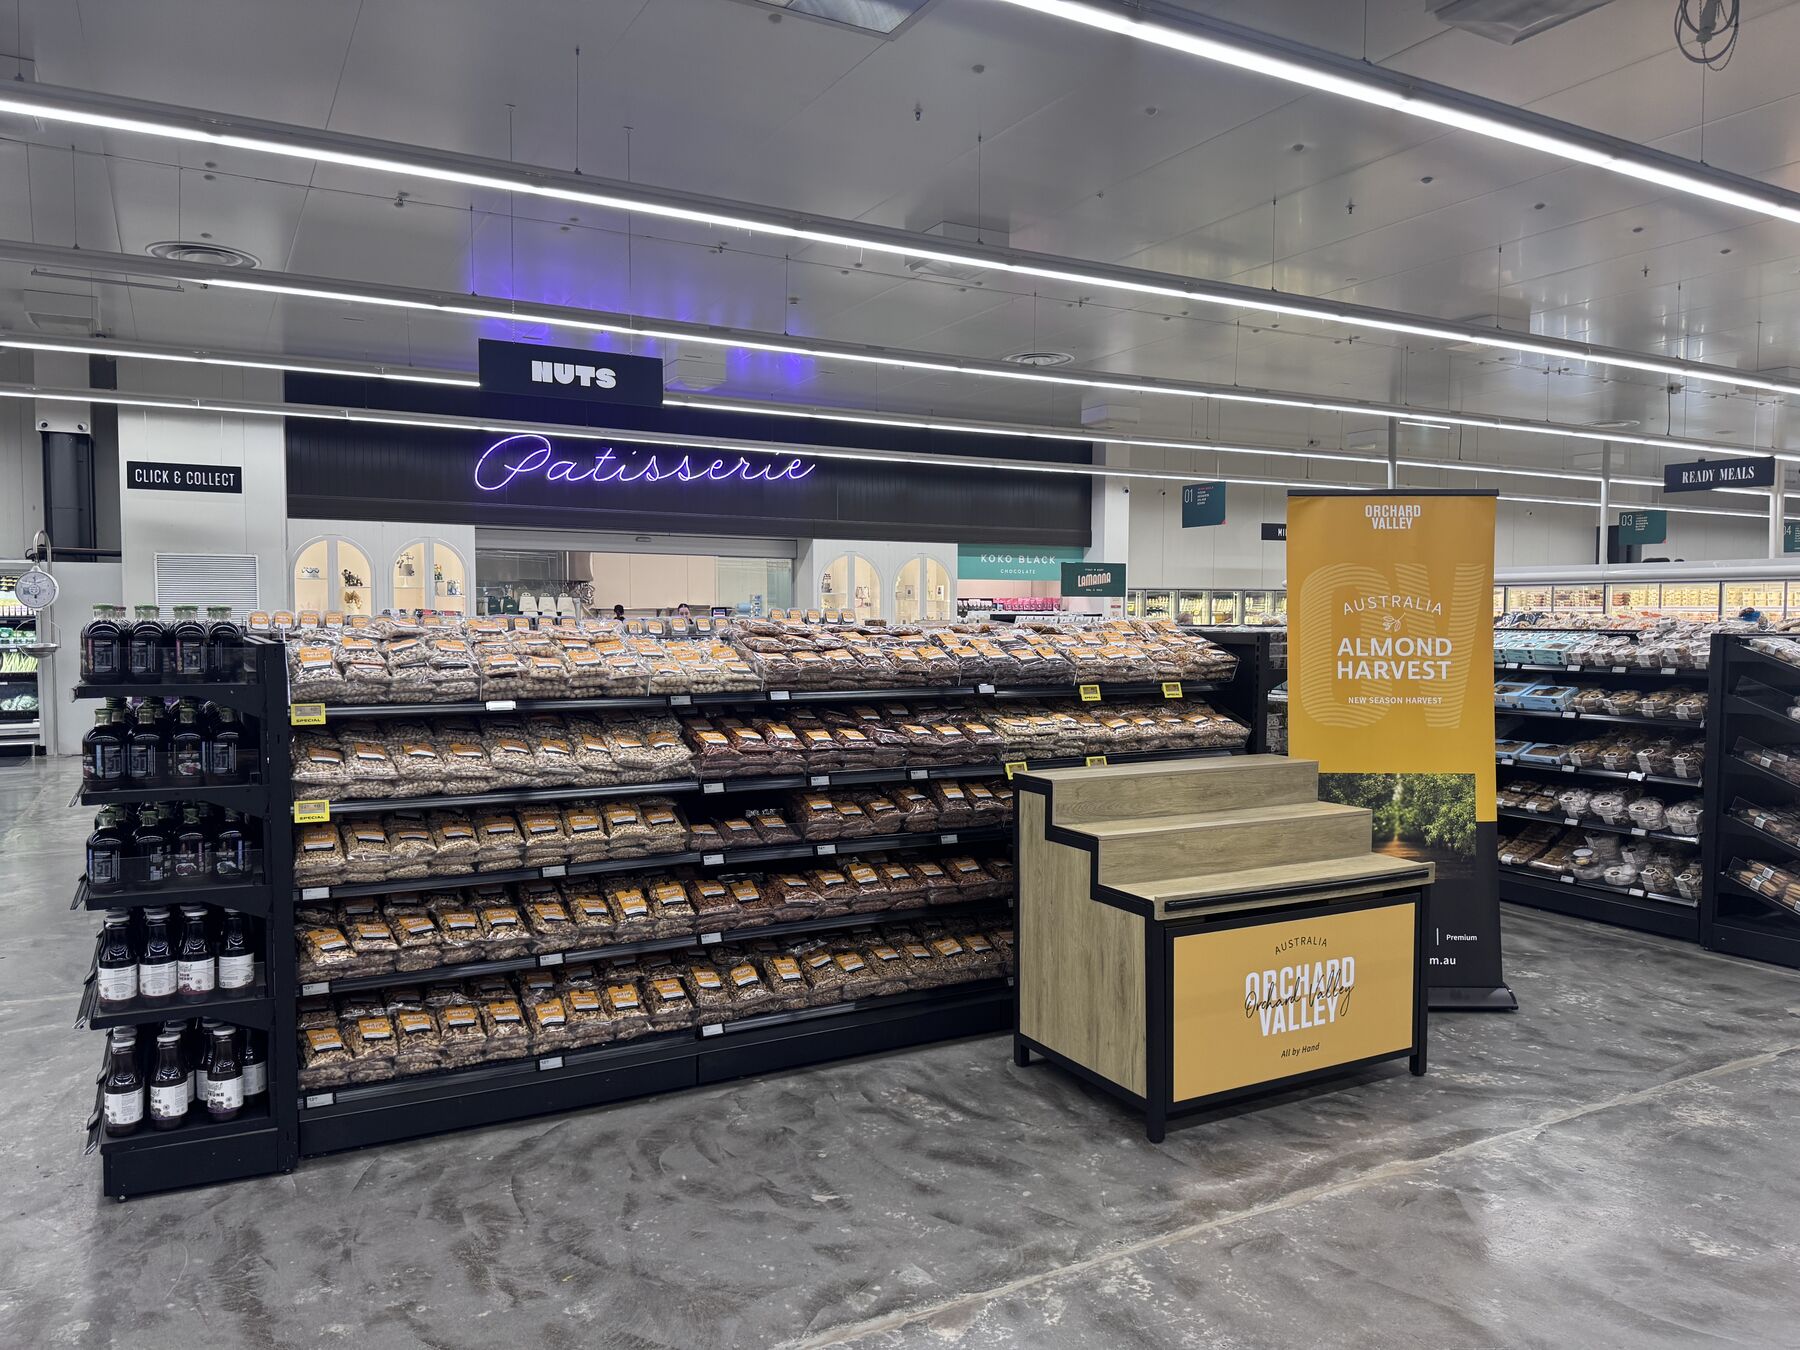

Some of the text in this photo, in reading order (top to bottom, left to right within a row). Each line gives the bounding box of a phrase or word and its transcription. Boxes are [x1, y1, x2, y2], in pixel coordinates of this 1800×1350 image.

[531, 360, 617, 389] NUTS
[475, 434, 816, 491] Patisserie
[135, 468, 235, 487] CLICK & COLLECT
[1682, 466, 1755, 484] READY MEALS
[1184, 488, 1193, 503] 01
[1365, 504, 1421, 518] ORCHARD
[1621, 514, 1633, 526] 03
[1371, 517, 1413, 529] VALLEY
[981, 554, 1056, 565] KOKO BLACK
[1343, 595, 1442, 616] AUSTRALIA
[1337, 637, 1453, 657] ALMOND
[1337, 660, 1452, 680] HARVEST
[1348, 696, 1443, 704] NEW SEASON HARVEST
[1275, 936, 1328, 955] AUSTRALIA
[1429, 957, 1457, 965] m.au
[1245, 956, 1355, 1004] ORCHARD
[1244, 969, 1355, 1019] Orchard Valley
[1258, 996, 1341, 1037] VALLEY
[1281, 1042, 1320, 1058] All by Hand
